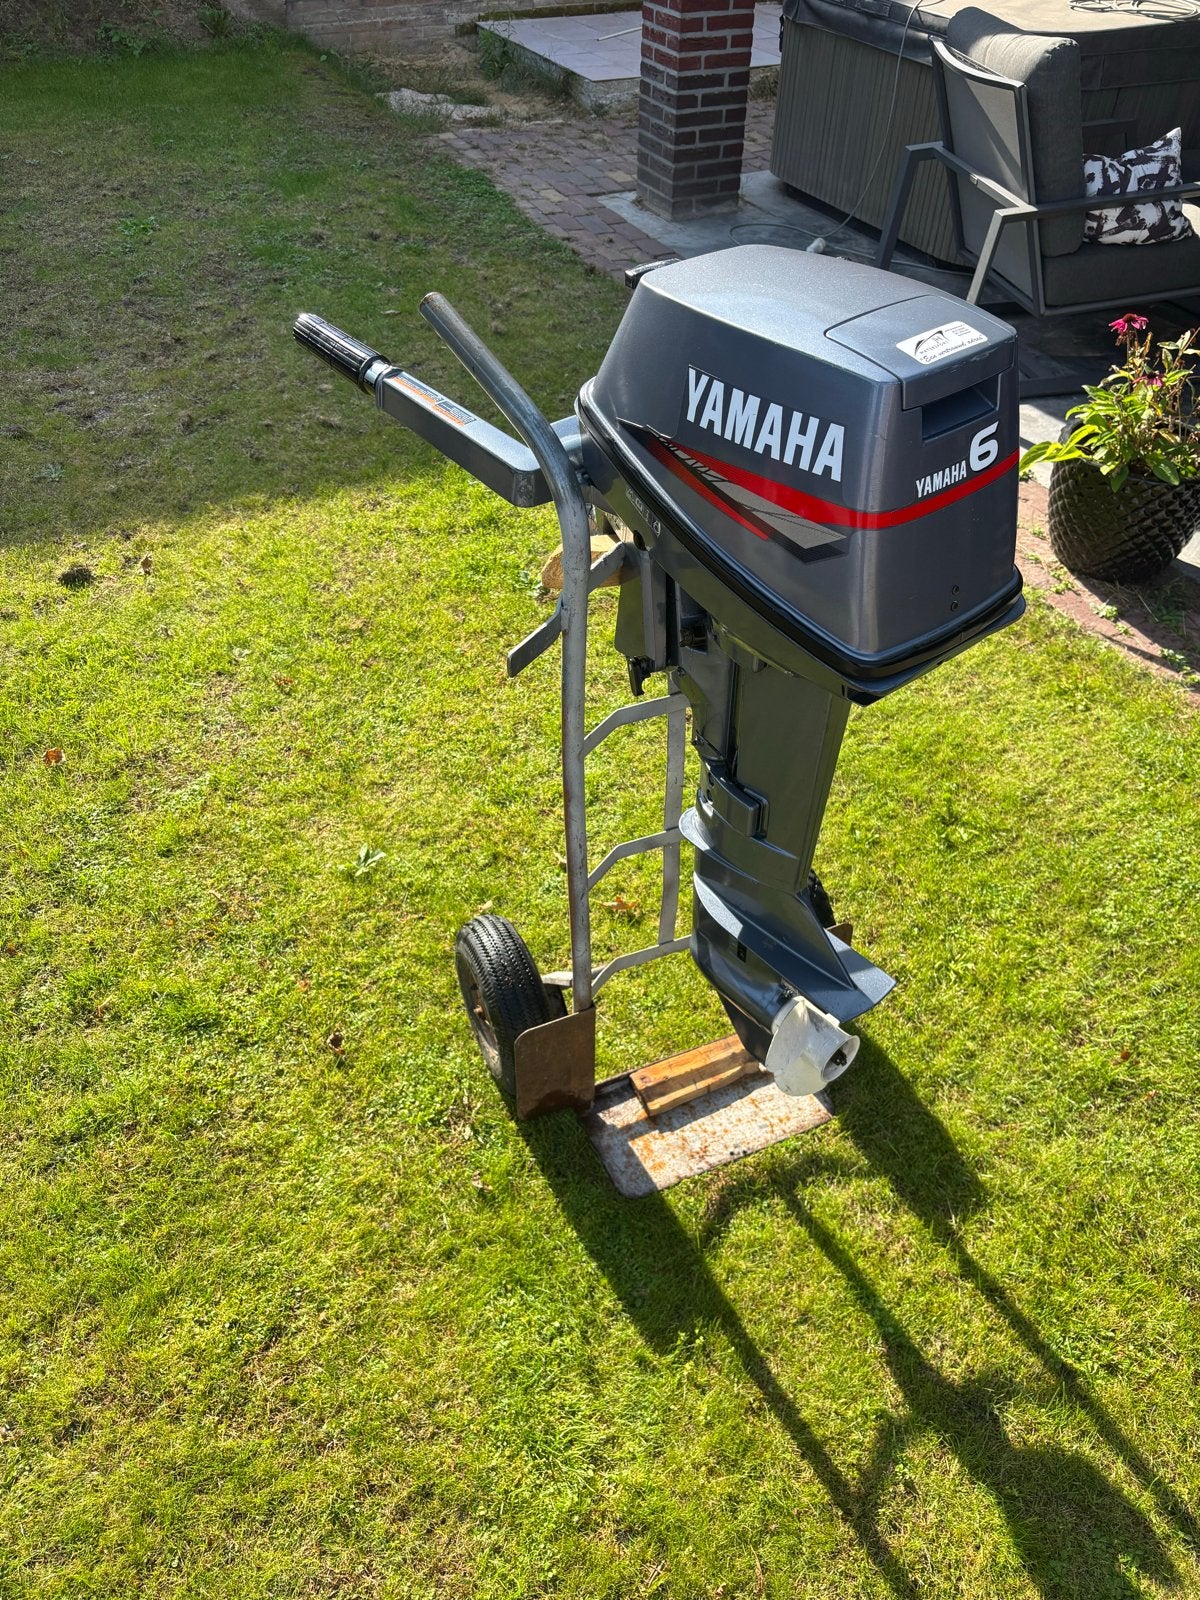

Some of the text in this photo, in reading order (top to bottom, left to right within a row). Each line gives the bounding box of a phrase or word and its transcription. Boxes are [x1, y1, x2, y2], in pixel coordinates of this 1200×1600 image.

[686, 367, 845, 482] YAMAHA
[915, 421, 999, 498] YAMAHA 6
